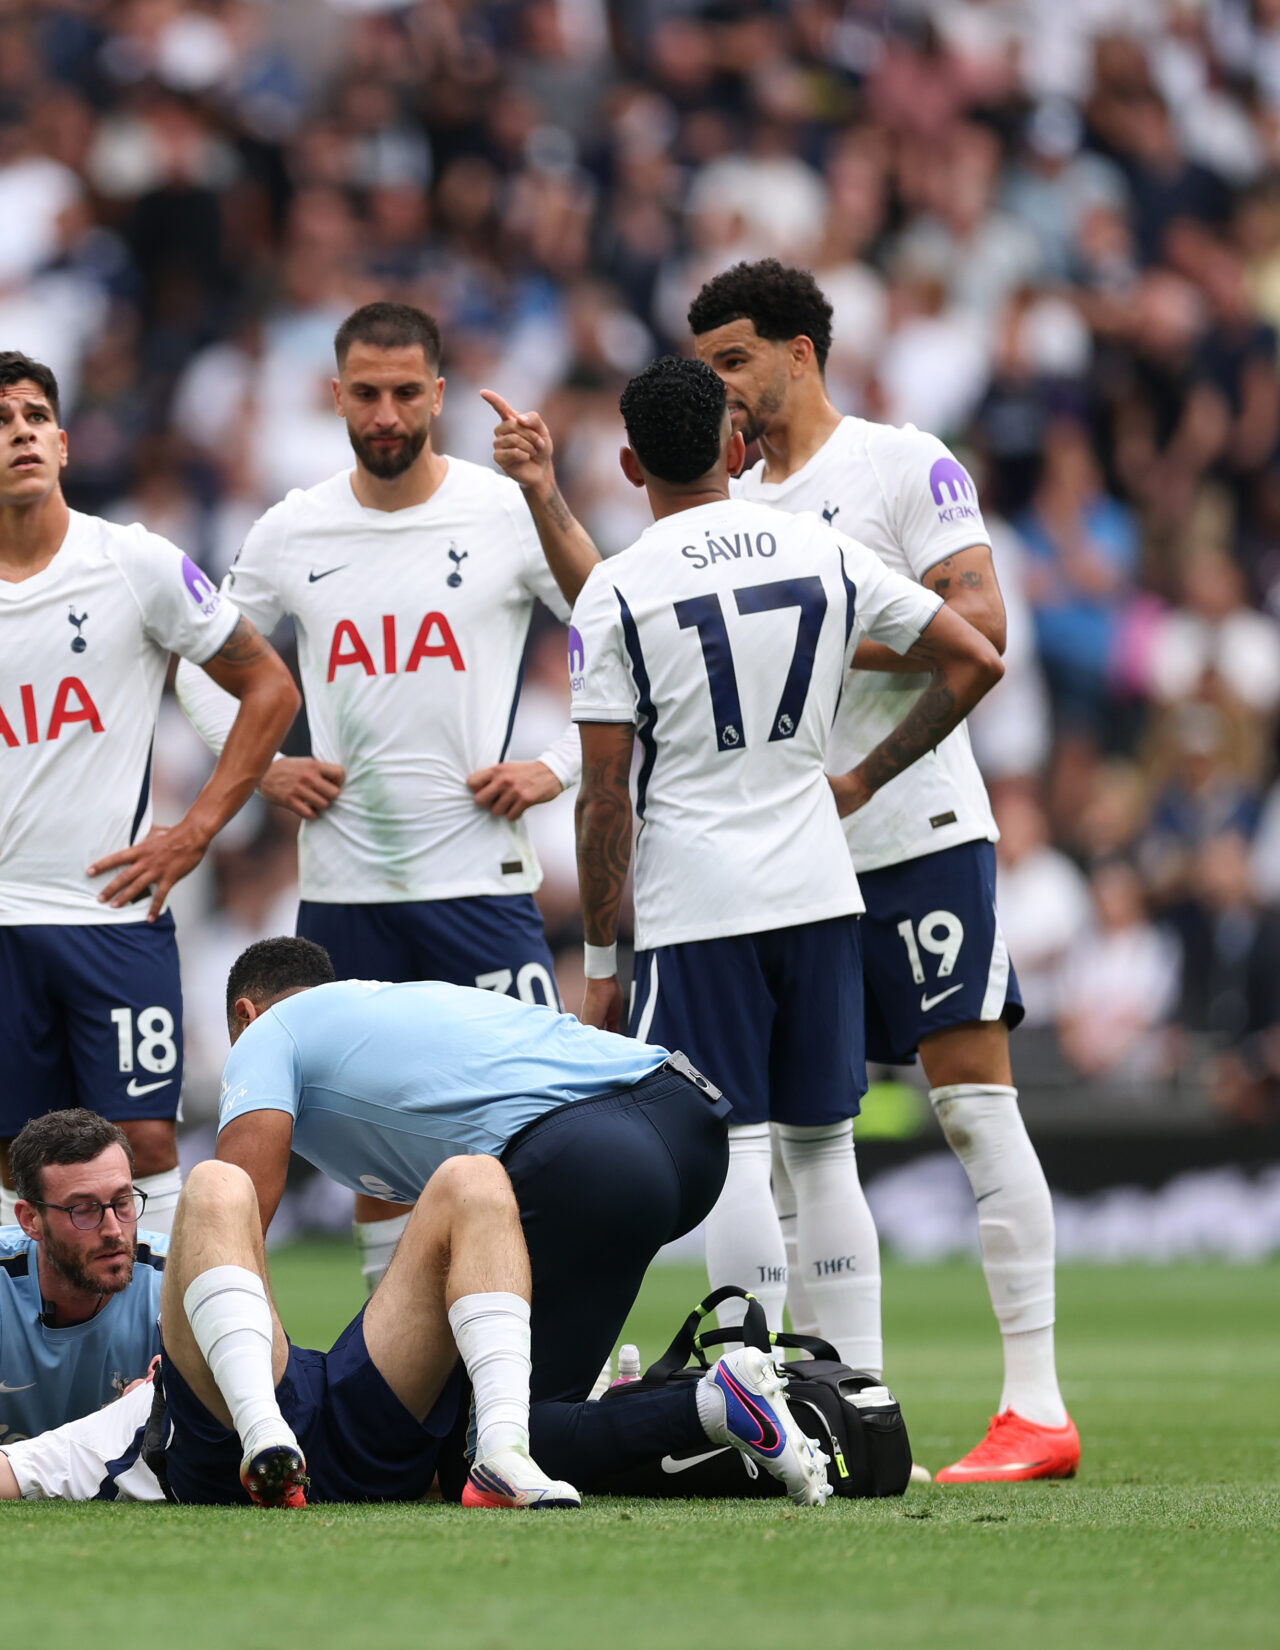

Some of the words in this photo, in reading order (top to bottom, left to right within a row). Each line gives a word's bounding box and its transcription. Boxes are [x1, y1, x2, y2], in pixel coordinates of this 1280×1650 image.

[681, 530, 777, 570] SÁVIO
[327, 611, 466, 683] AIA
[673, 575, 828, 752] 17
[569, 676, 586, 692] en
[896, 910, 965, 985] 19
[111, 1006, 178, 1074] 18
[813, 1255, 856, 1277] THFC
